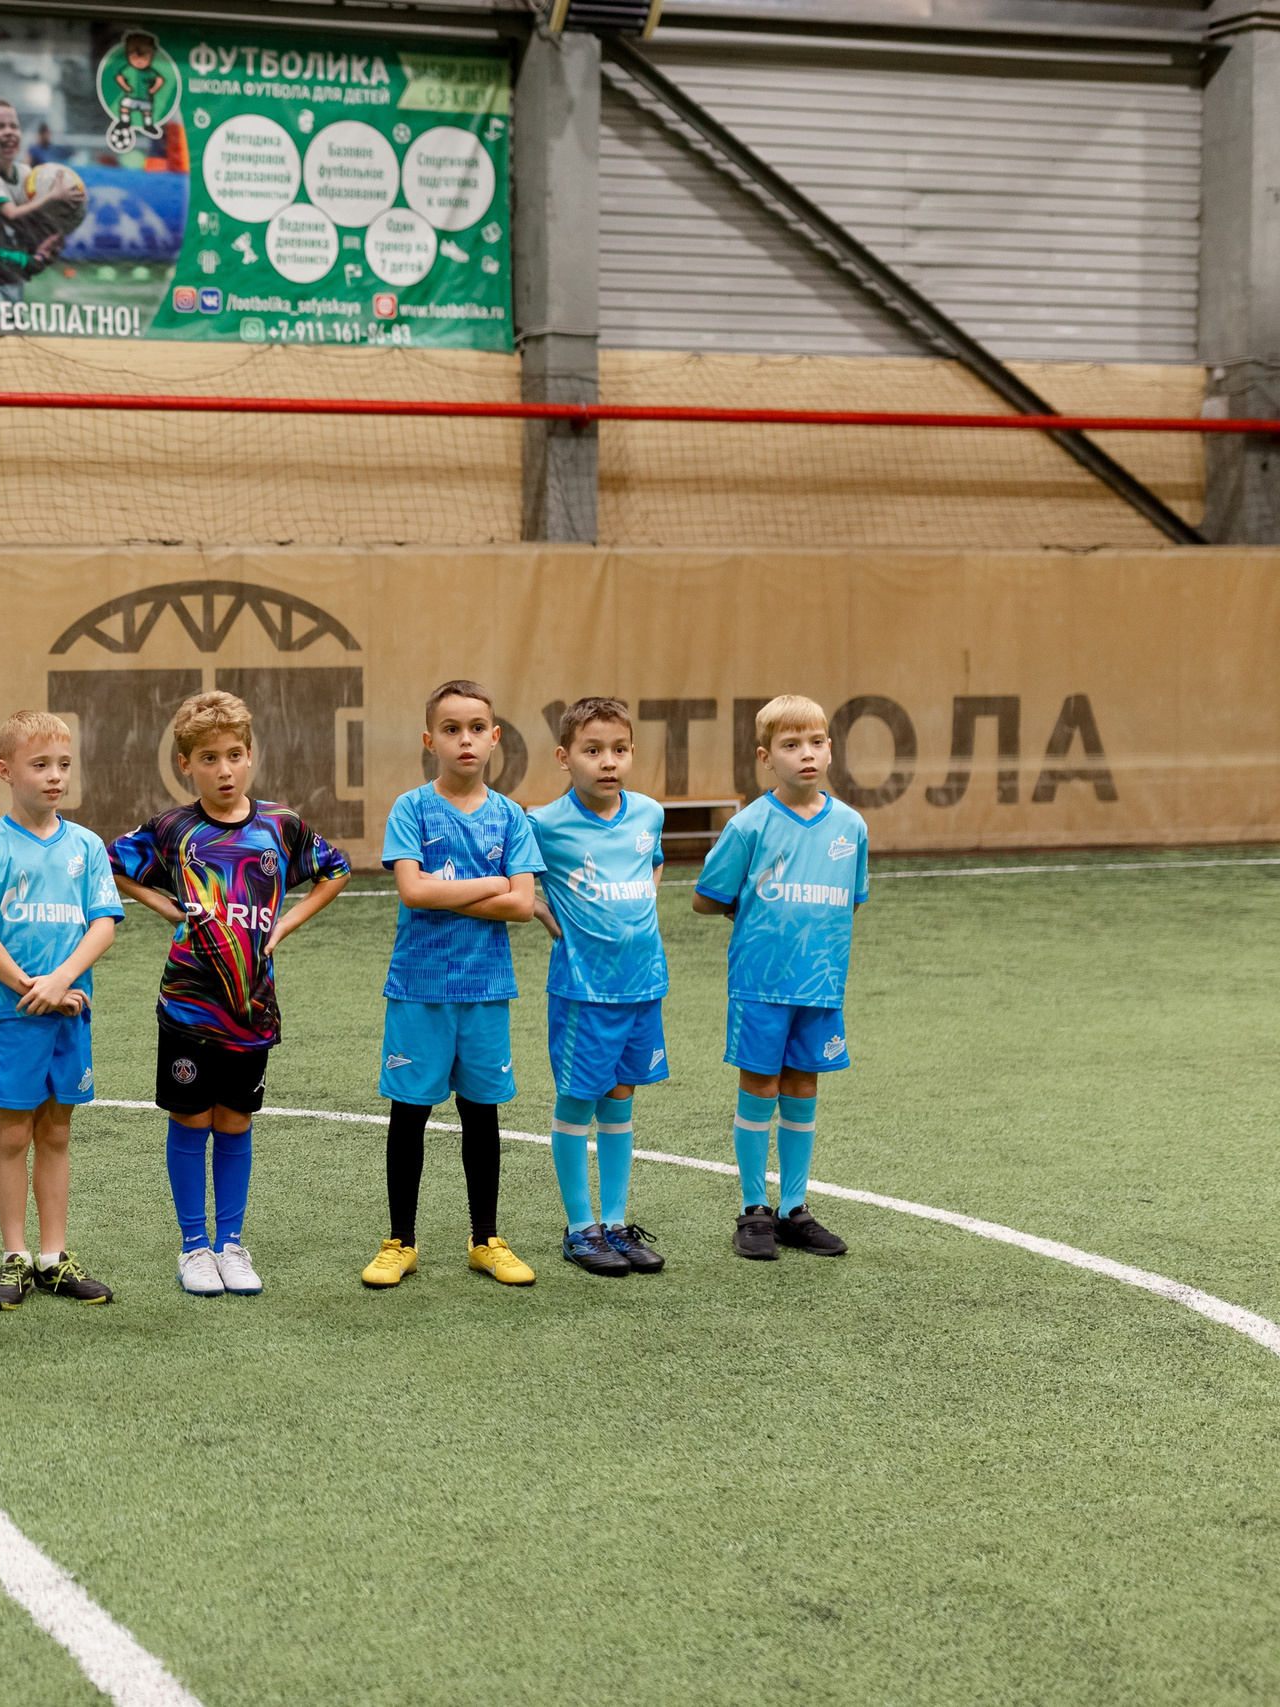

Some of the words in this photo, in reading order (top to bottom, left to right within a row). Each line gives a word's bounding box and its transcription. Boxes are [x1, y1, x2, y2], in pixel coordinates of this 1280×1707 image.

[188, 42, 391, 86] ФУТБОЛИКА
[188, 77, 242, 96] ШКОЛА
[242, 80, 311, 100] ФУТБОЛА
[312, 85, 342, 103] ДЛЯ
[343, 86, 391, 105] ДЕТЕЙ
[225, 131, 282, 147] Методика
[327, 142, 374, 159] Базовое
[221, 152, 287, 167] тренировок
[223, 170, 292, 184] доказанной
[317, 162, 385, 180] футбольное
[315, 183, 388, 201] образование
[278, 217, 327, 232] Ведение
[386, 217, 416, 234] Один
[275, 235, 330, 249] дневника
[374, 240, 413, 255] тренер
[276, 252, 329, 267] футболиста
[389, 260, 424, 275] детей
[422, 693, 1120, 809] ФТОЛА
[601, 880, 656, 902] ГАЗПРО
[784, 883, 850, 908] ГАЗПРОМ
